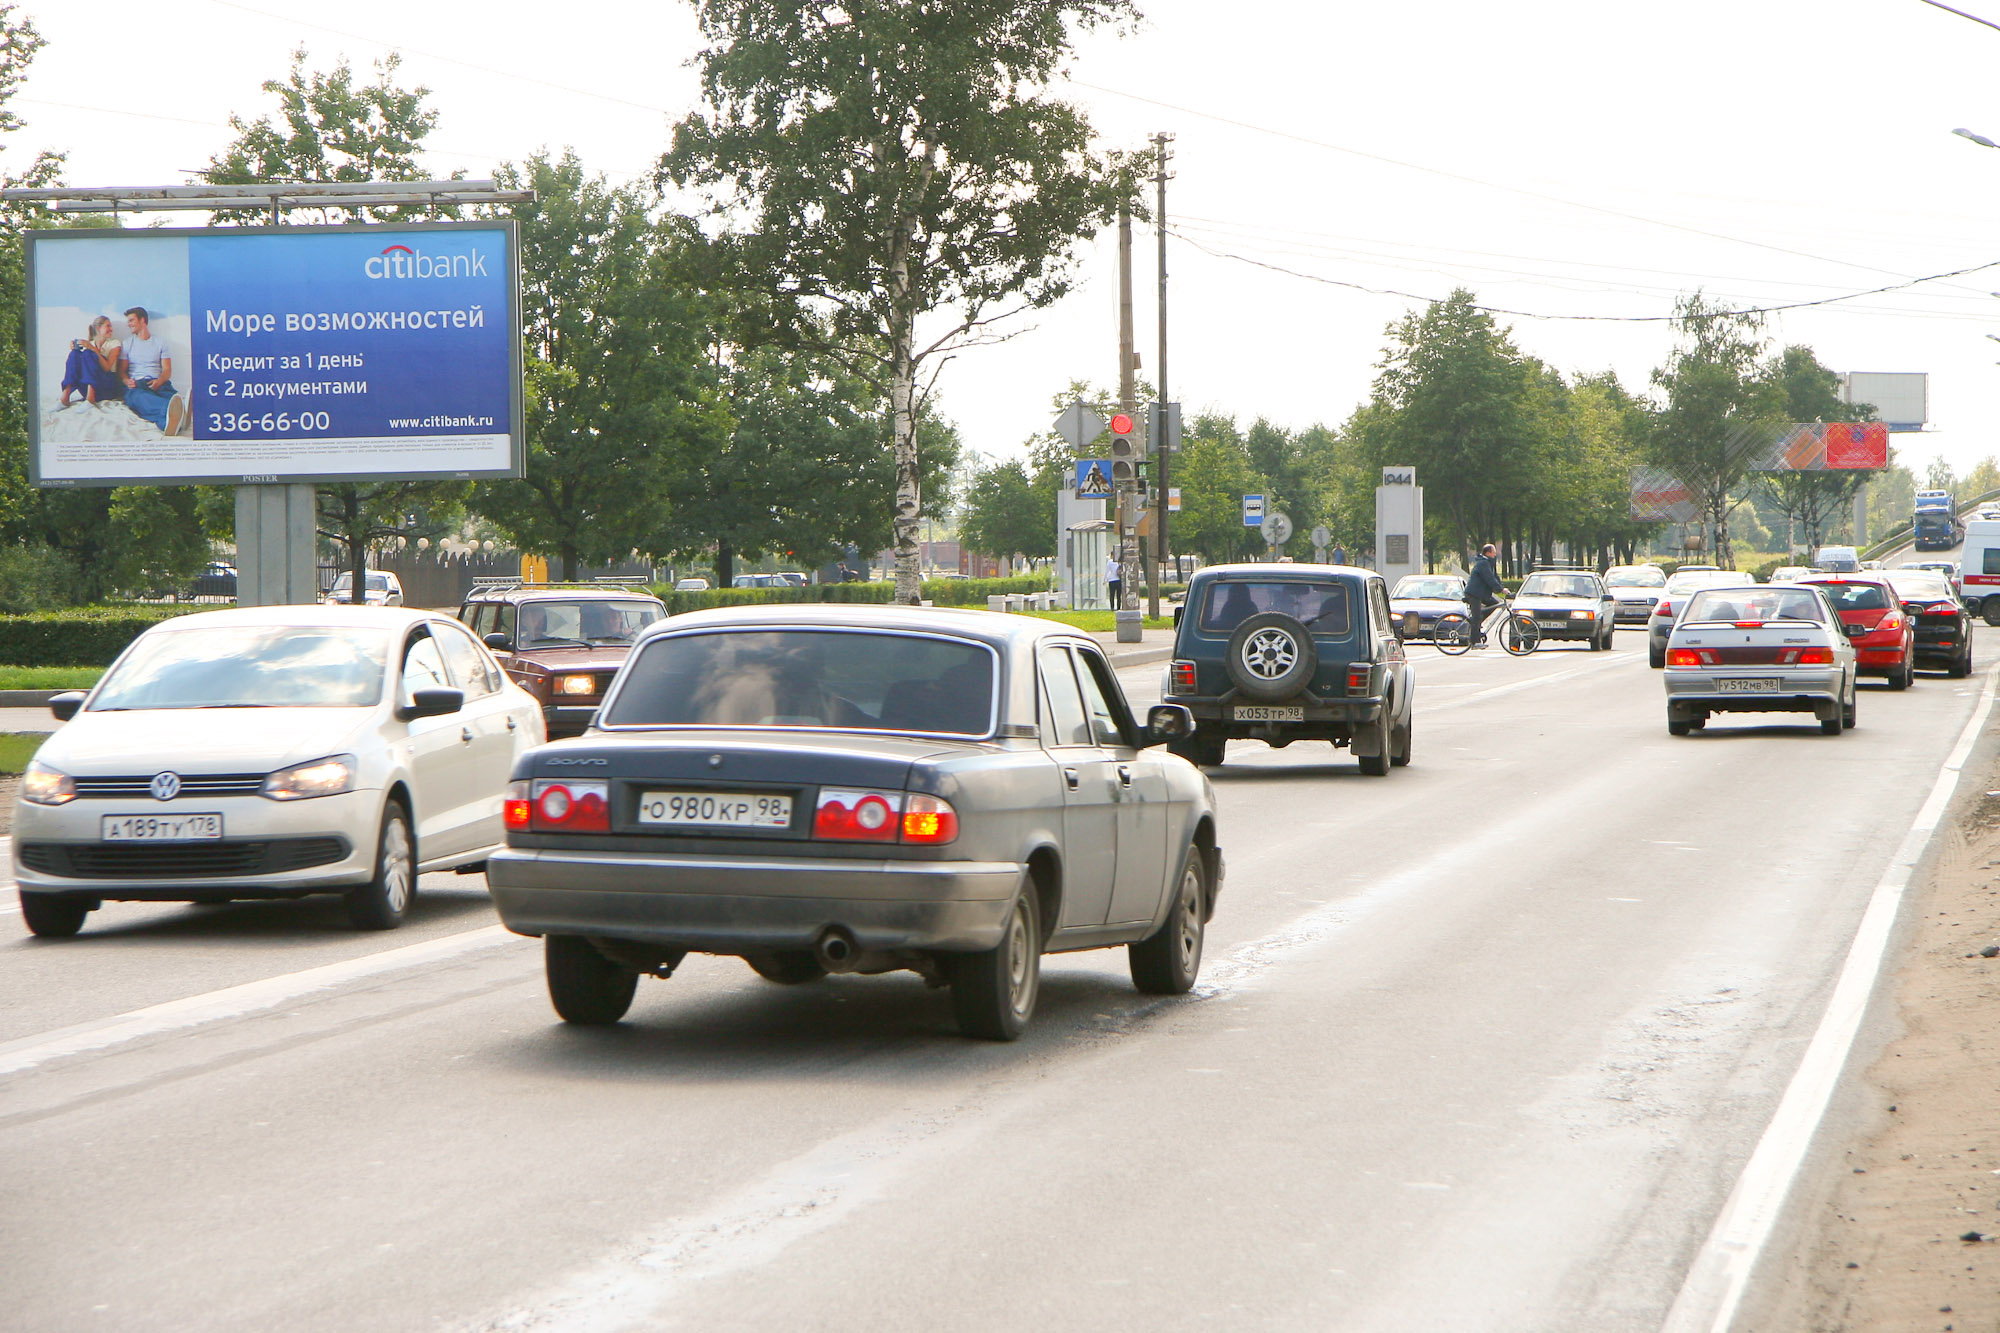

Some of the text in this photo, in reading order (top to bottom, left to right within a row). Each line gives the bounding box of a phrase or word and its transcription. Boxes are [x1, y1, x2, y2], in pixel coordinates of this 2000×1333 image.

[364, 246, 488, 278] citibank
[206, 304, 484, 338] Море возможностей
[207, 352, 362, 373] Кредит за 1 день
[208, 379, 367, 400] с 2 документами
[208, 411, 330, 432] 336-66-00
[389, 415, 493, 428] www.citibank.ru
[1384, 474, 1412, 485] 1944
[1725, 681, 1761, 690] У512МВ
[1239, 707, 1300, 719] Х053ТР 98
[650, 796, 782, 821] О980КР 98
[109, 816, 218, 838] А189ТУ 178
